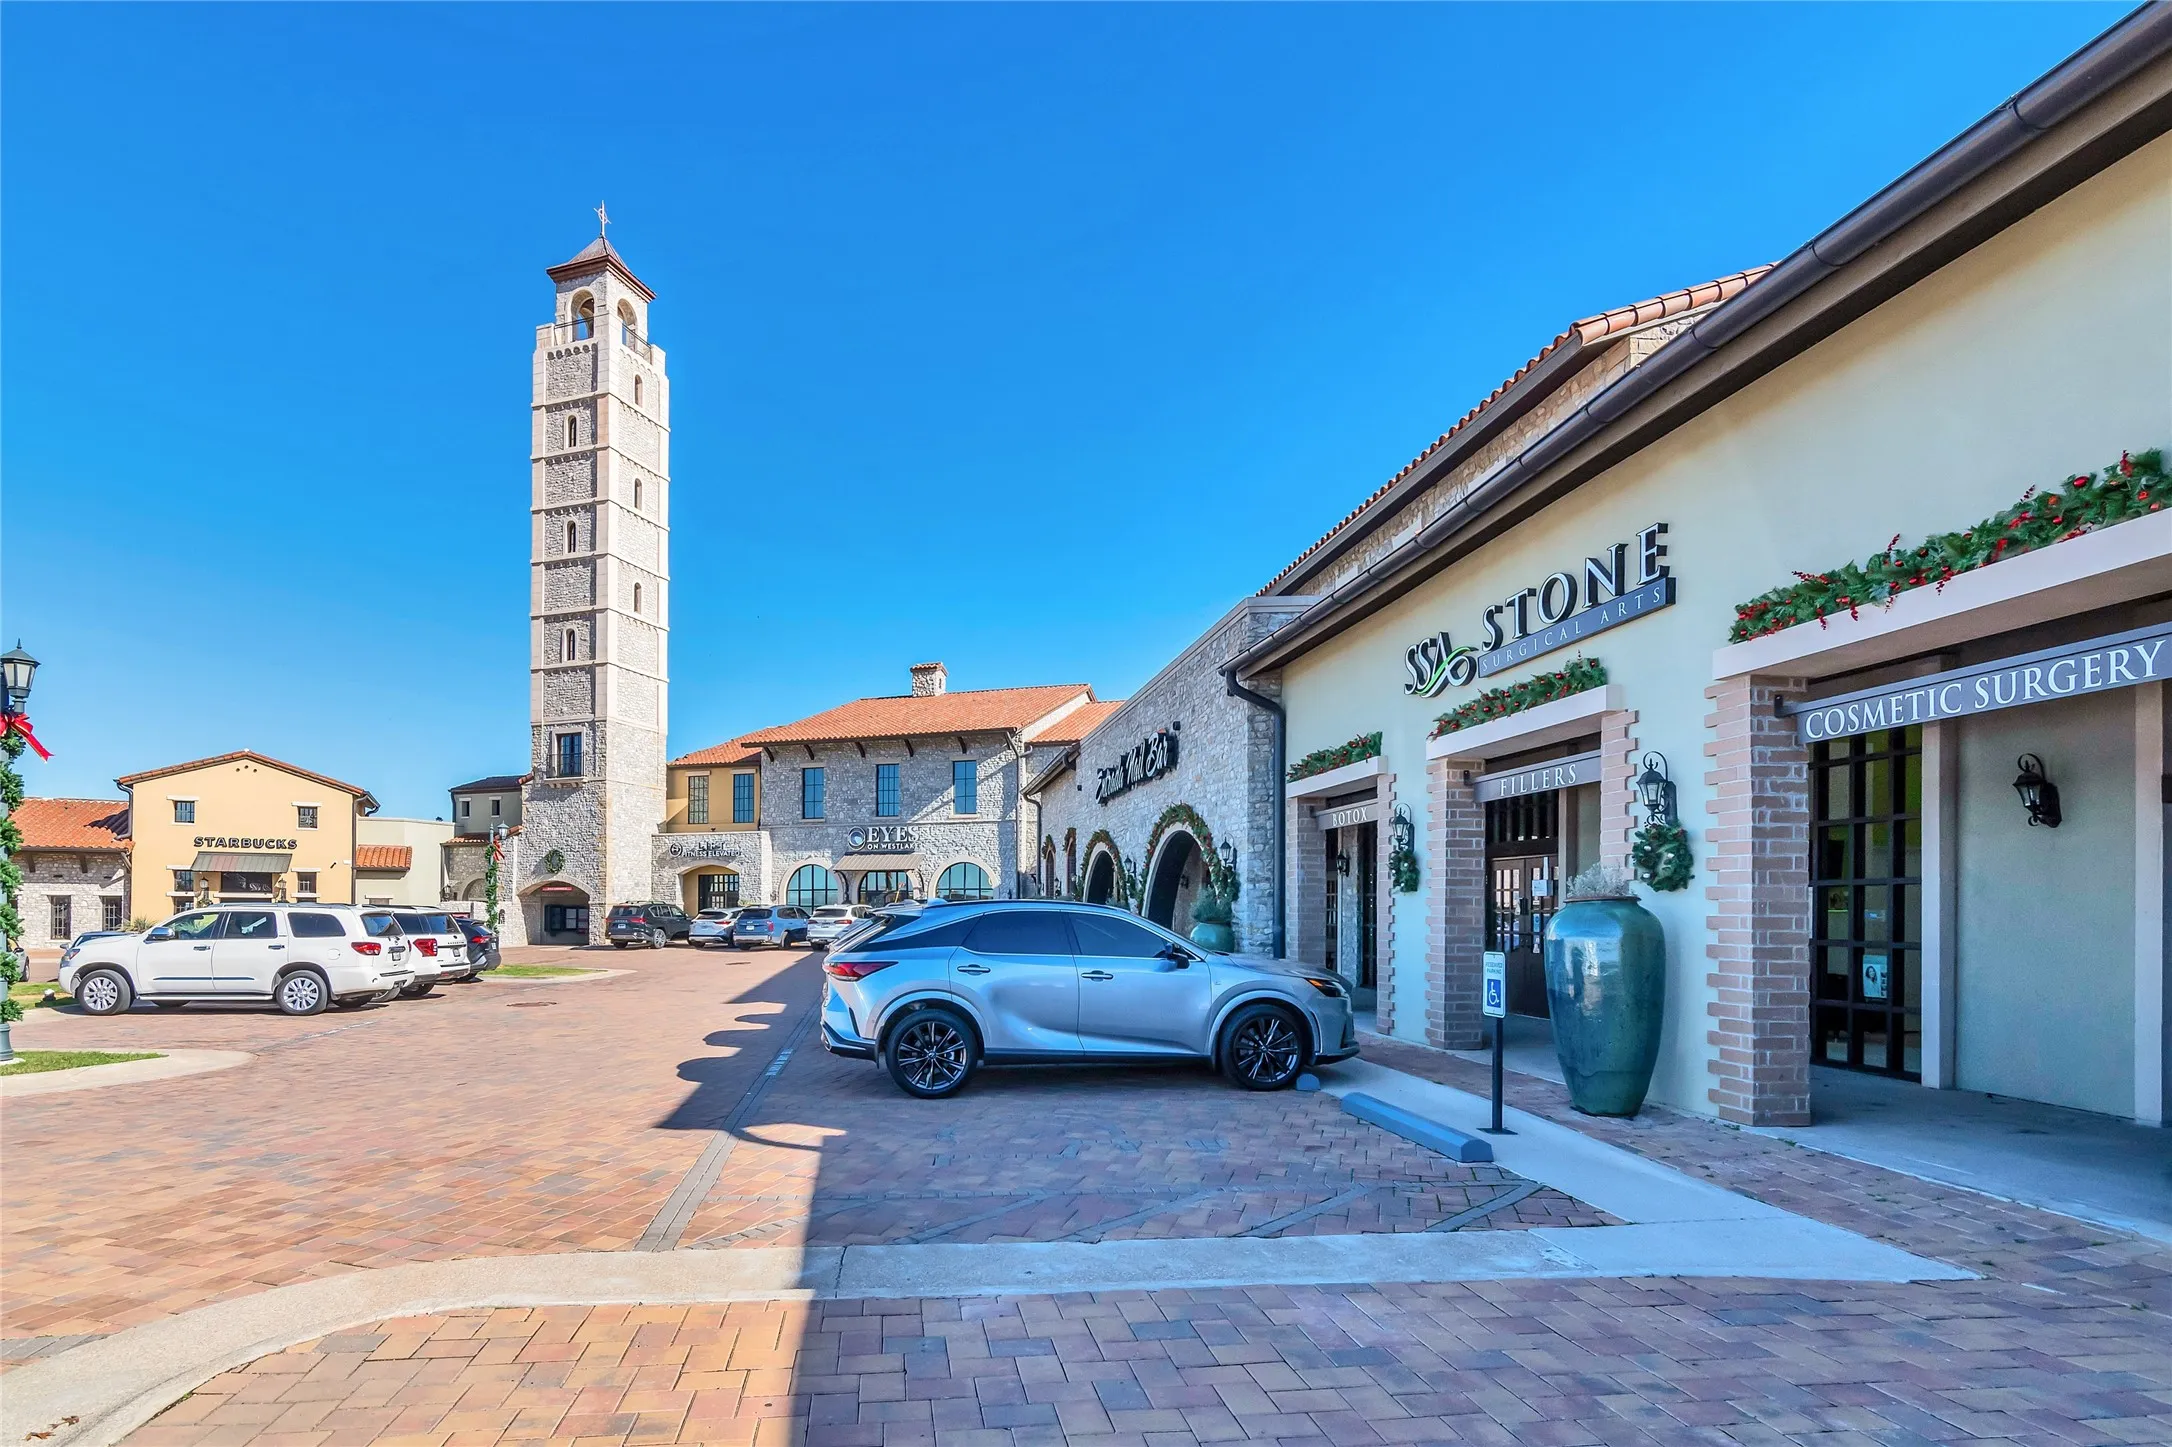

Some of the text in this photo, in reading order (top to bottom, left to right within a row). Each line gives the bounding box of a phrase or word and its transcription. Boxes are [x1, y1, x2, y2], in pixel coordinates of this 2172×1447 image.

[1482, 522, 1670, 652] STONE
[1481, 586, 1661, 672] SURGICAL ARTS
[1805, 639, 2166, 739] COSMETIC SURGERY
[1500, 764, 1577, 797] FILLERS
[1332, 806, 1368, 827] BOTOX
[193, 836, 297, 850] STARBUCKS
[867, 826, 919, 843] EYES
